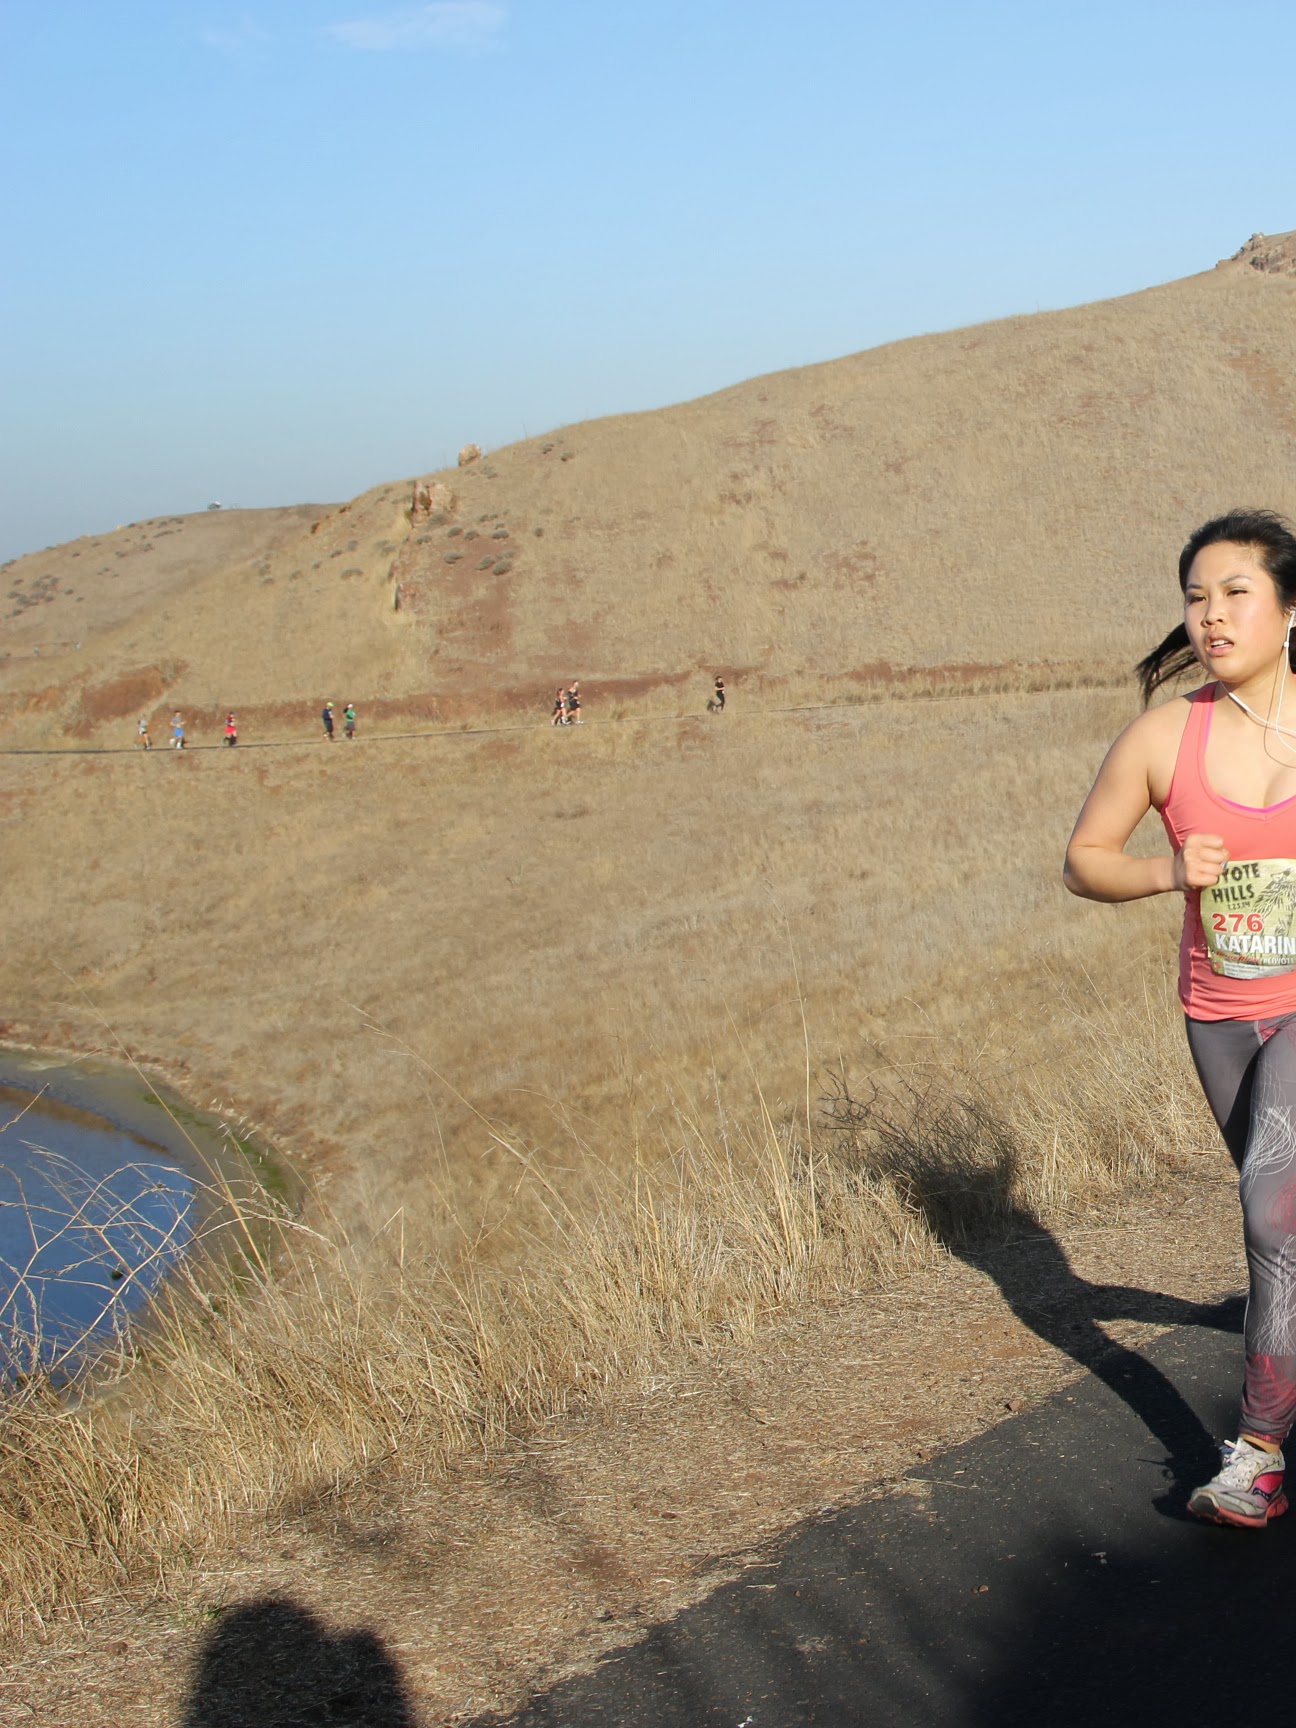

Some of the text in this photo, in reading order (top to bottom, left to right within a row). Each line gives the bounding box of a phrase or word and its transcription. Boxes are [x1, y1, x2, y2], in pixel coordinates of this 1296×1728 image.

[1221, 862, 1260, 883] YOTE
[1211, 884, 1255, 903] HILLS
[1211, 912, 1263, 933] 276
